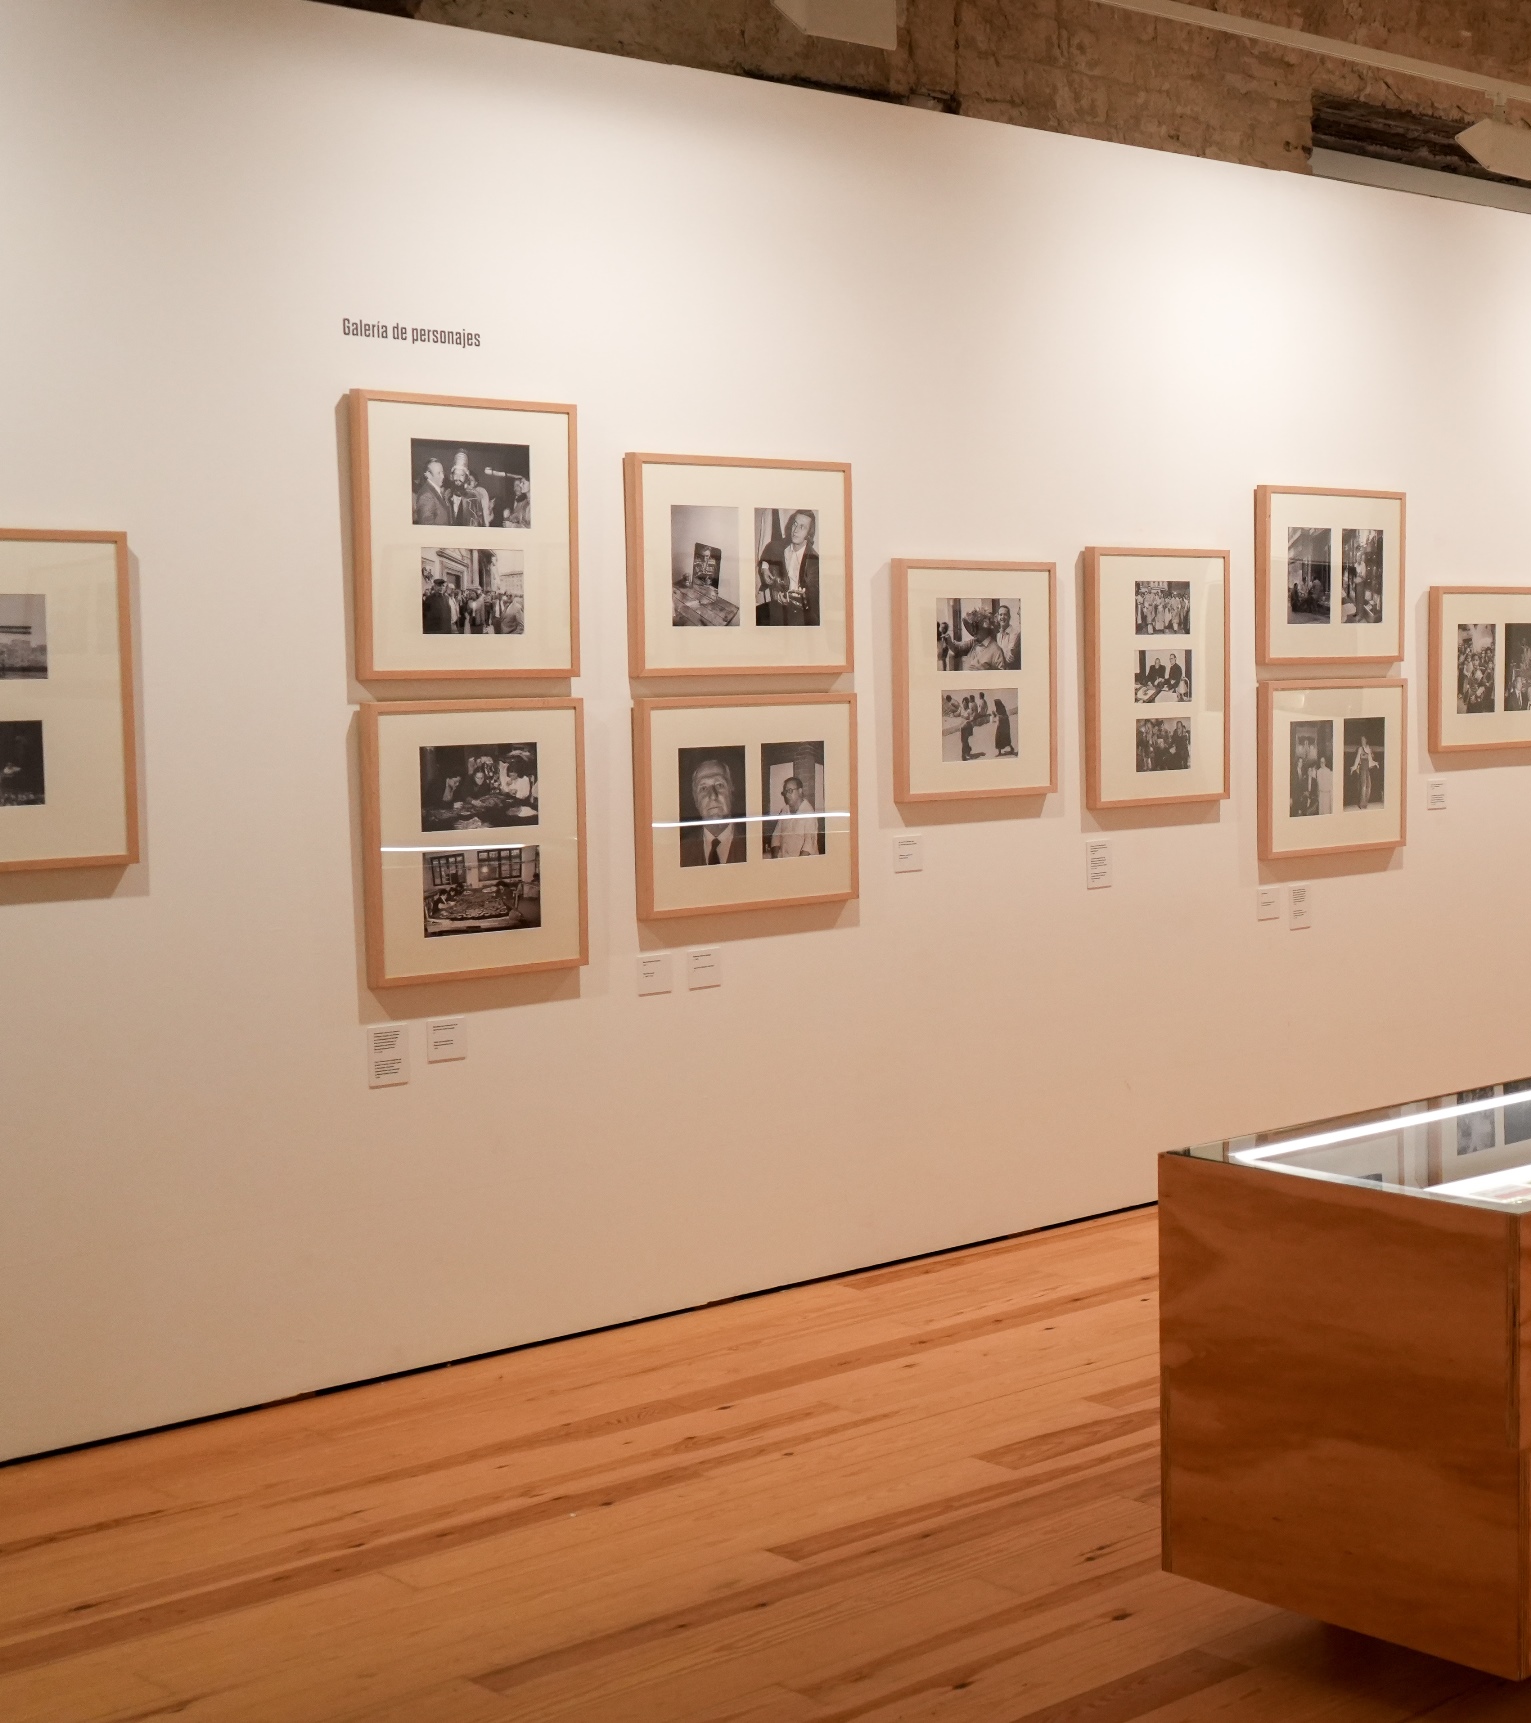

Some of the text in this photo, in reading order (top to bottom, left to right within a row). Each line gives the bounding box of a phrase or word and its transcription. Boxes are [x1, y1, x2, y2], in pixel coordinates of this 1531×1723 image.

[342, 317, 481, 349] Galería de personajes
